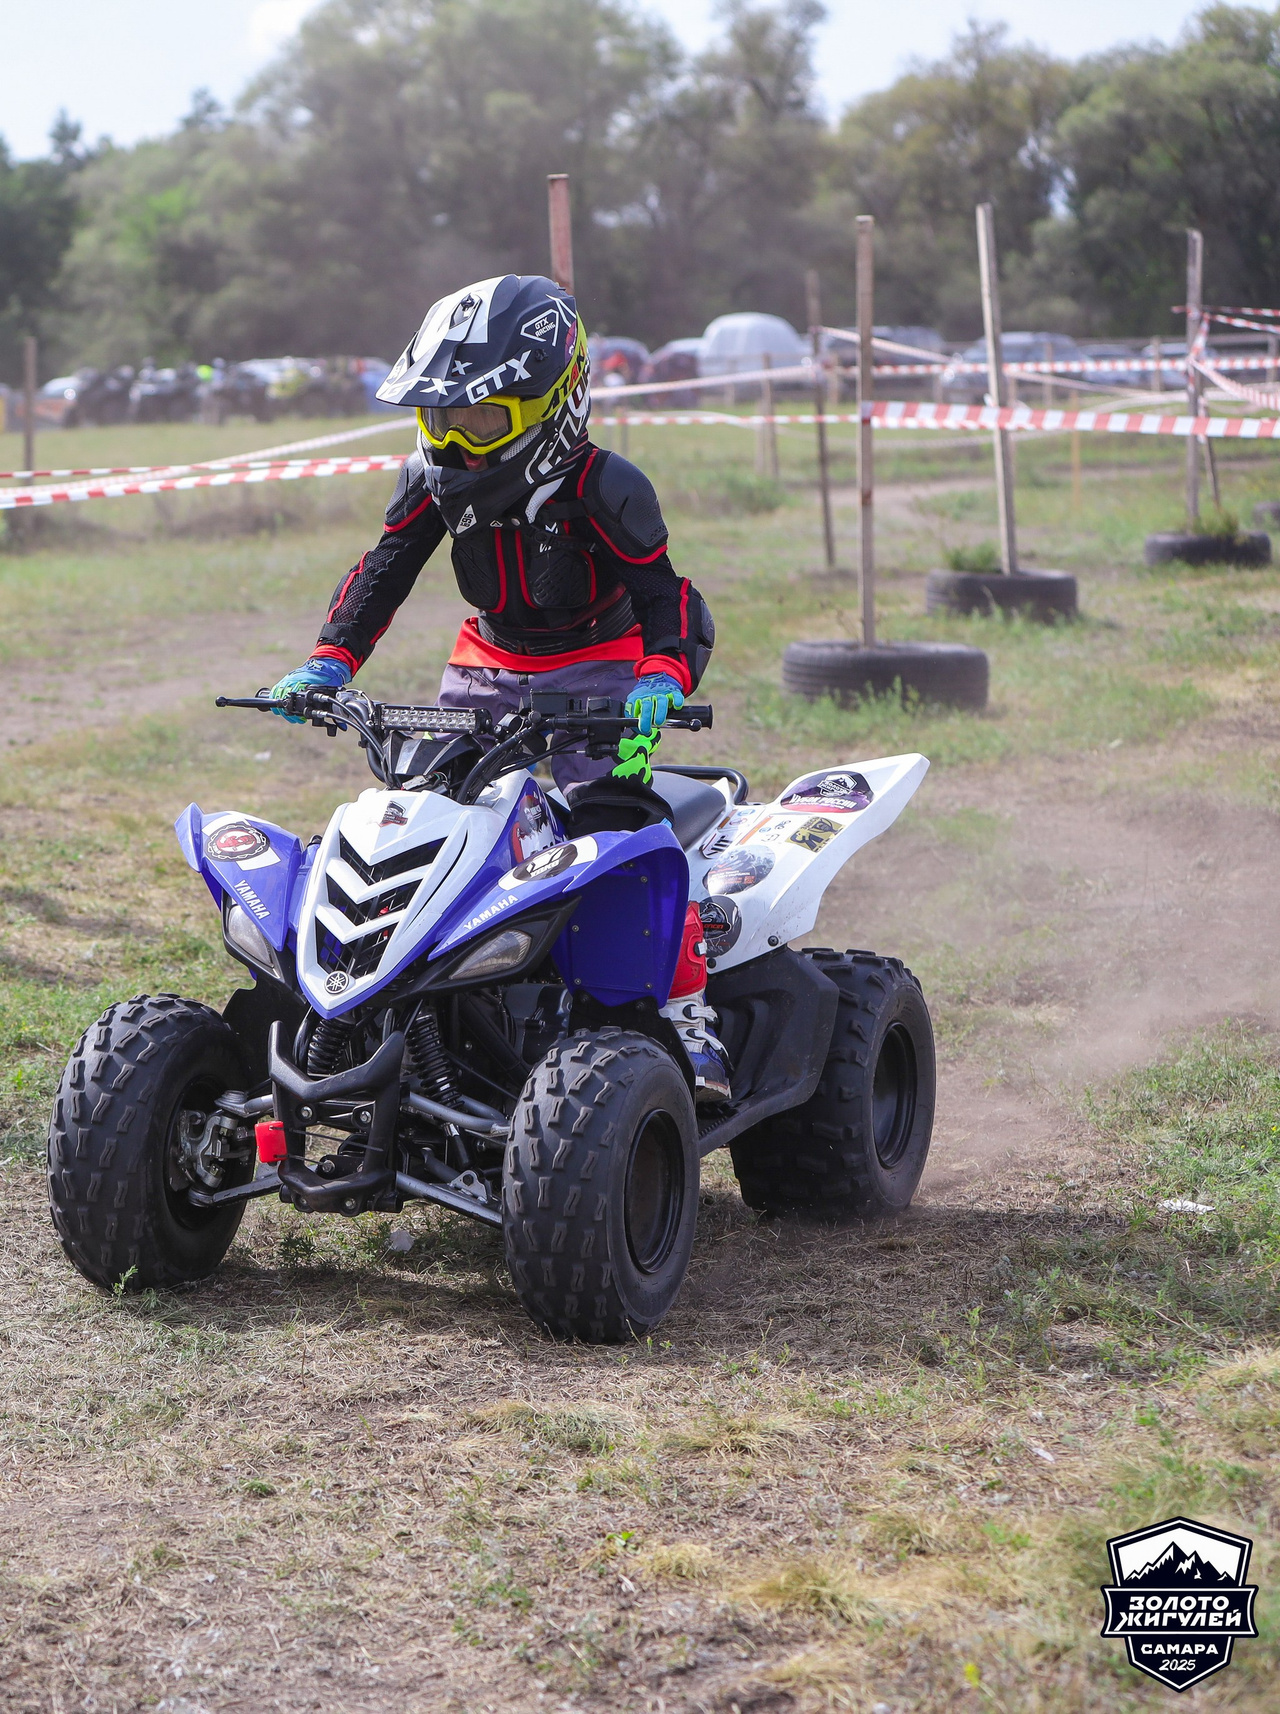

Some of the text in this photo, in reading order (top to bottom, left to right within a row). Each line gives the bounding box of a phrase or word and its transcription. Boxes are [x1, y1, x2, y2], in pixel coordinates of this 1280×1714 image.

[534, 316, 549, 330] GTX
[534, 321, 556, 338] RACING
[465, 350, 532, 405] GTX
[233, 879, 271, 920] YAMAHA
[463, 894, 519, 931] YAMAHA
